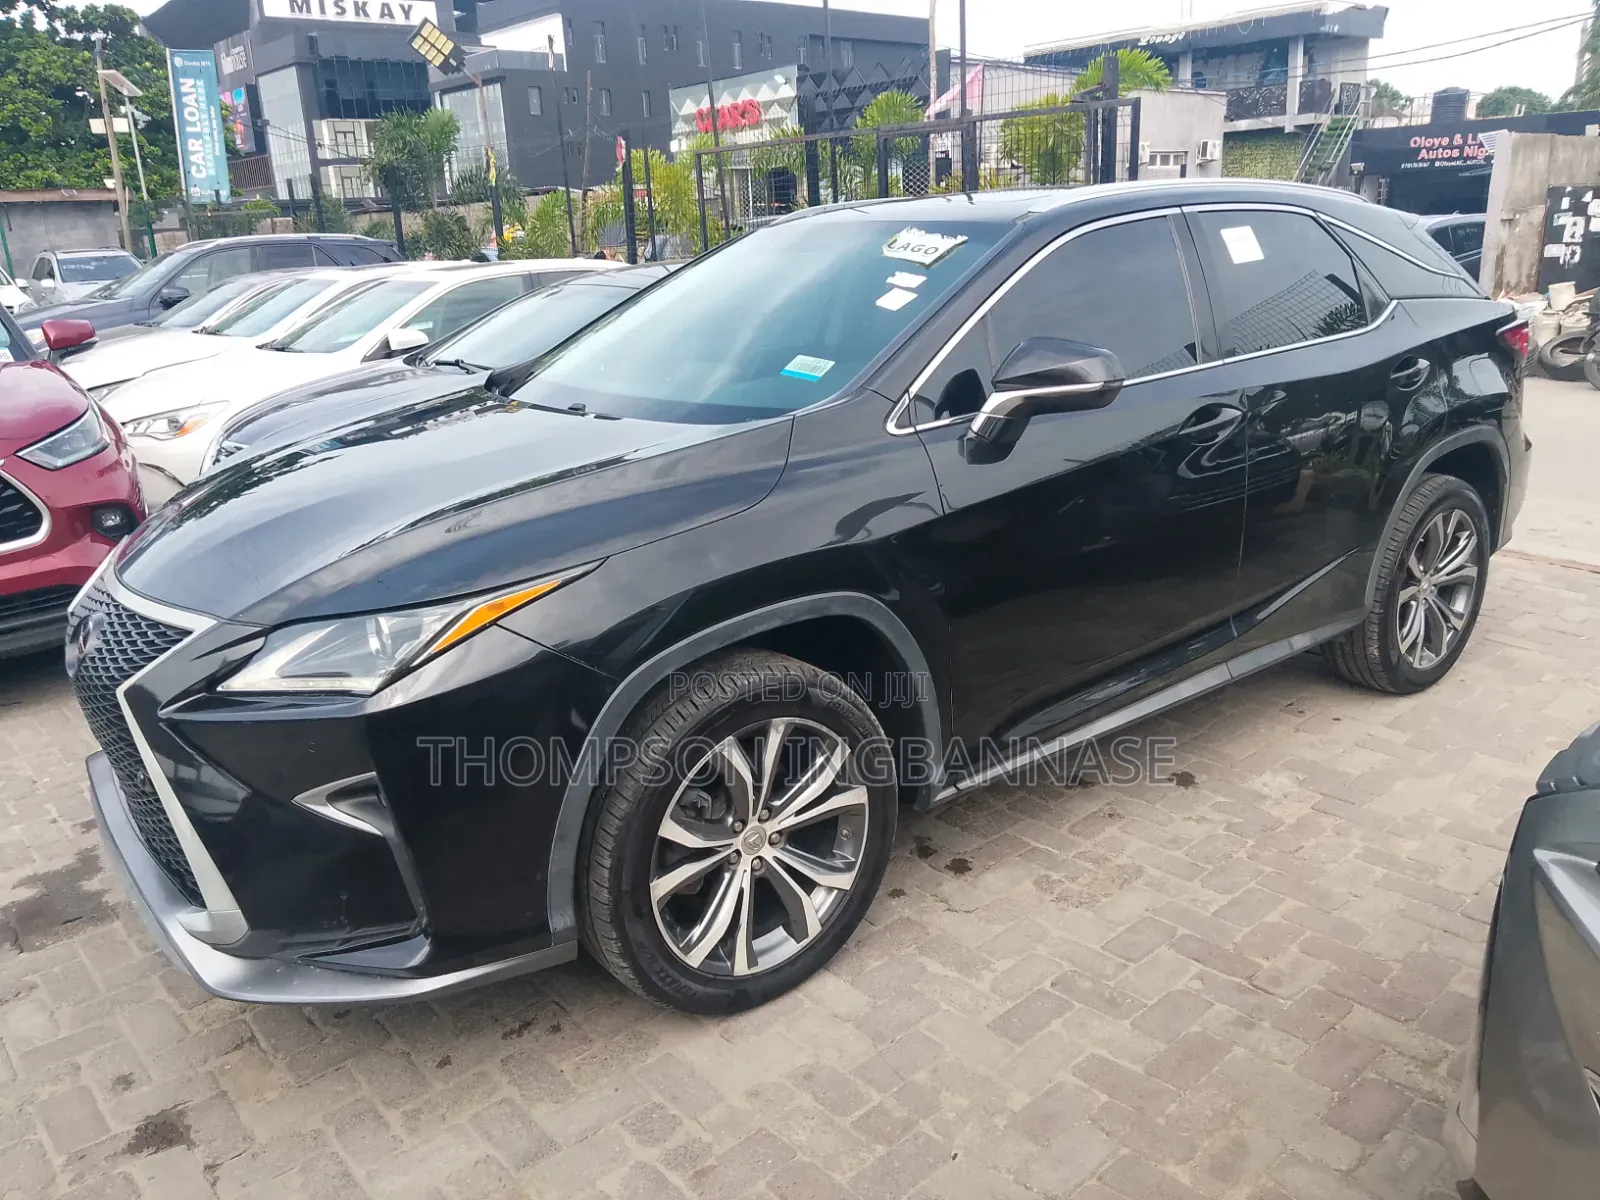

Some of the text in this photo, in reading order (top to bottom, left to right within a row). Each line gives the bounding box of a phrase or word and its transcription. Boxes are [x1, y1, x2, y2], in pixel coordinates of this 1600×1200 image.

[288, 0, 413, 20] MISKAY
[179, 77, 206, 178] CAR LOAN
[1410, 136, 1450, 149] Oloye
[1453, 133, 1463, 145] &
[1418, 148, 1460, 160] Autos
